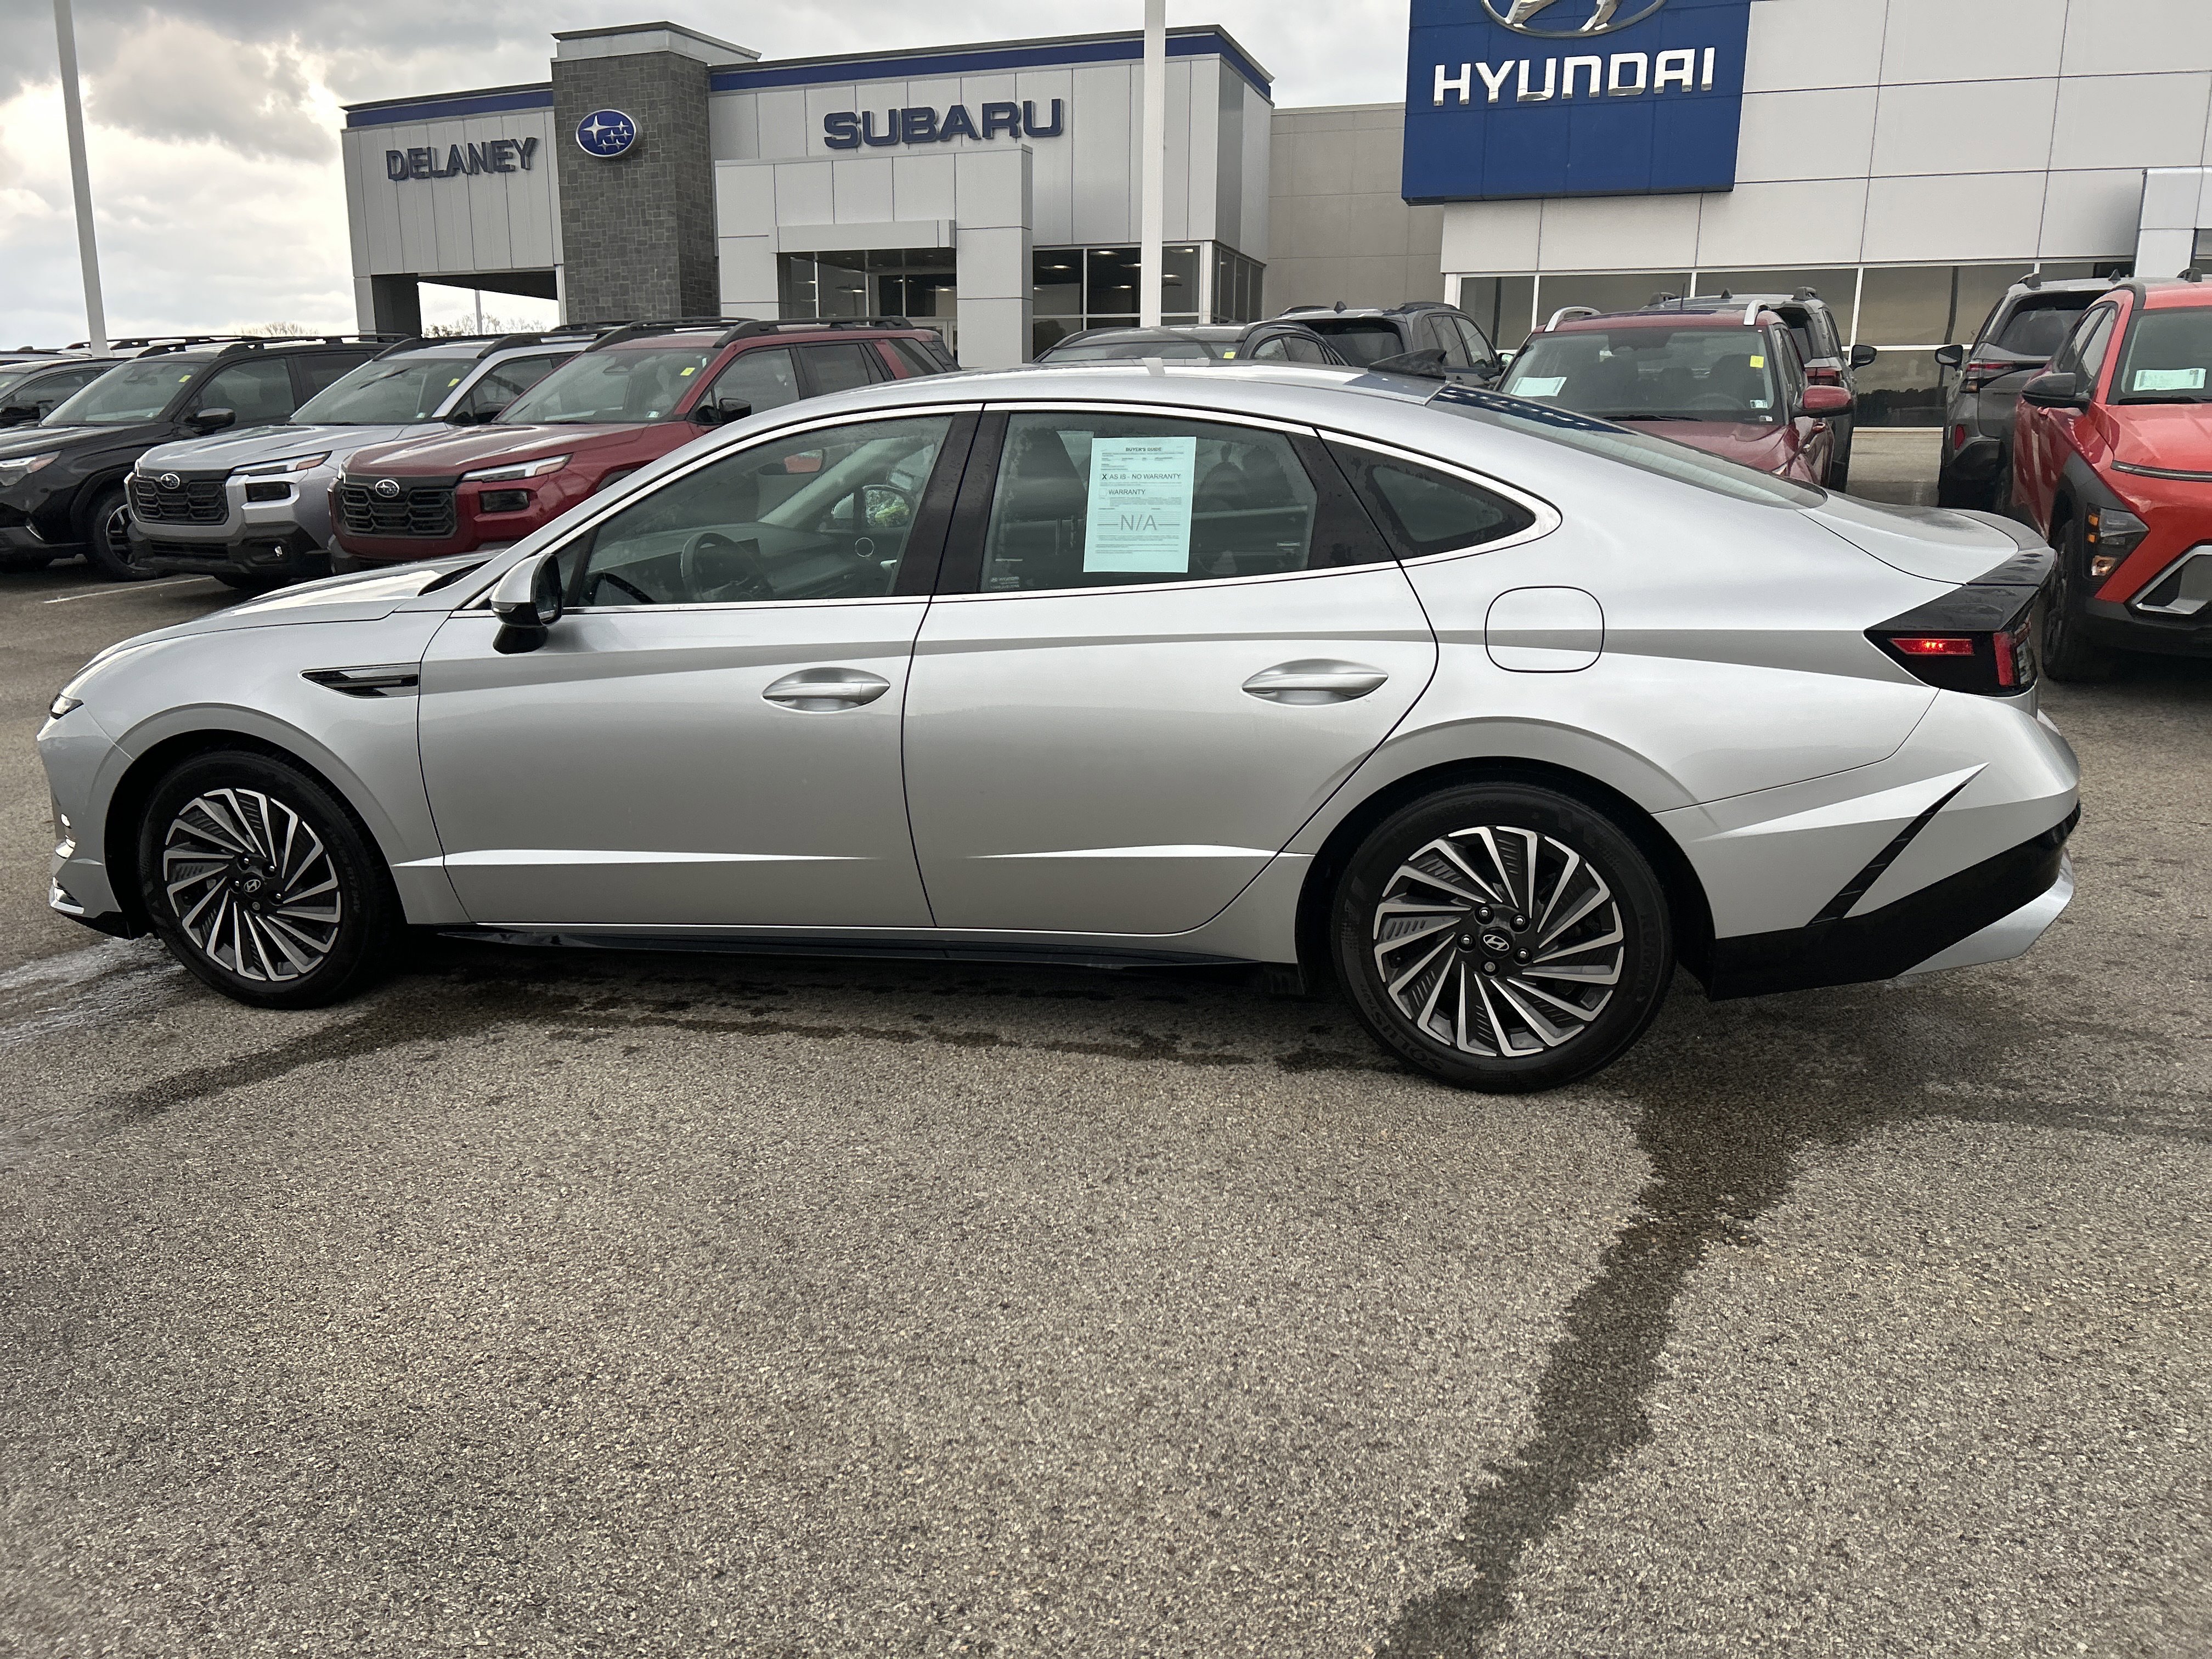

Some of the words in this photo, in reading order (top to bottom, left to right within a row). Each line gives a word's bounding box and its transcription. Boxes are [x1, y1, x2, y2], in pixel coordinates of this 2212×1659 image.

[1432, 47, 1715, 106] HYUNDAI
[823, 98, 1064, 149] SUBARU
[385, 137, 537, 180] DELANEY
[1120, 514, 1158, 531] N/A
